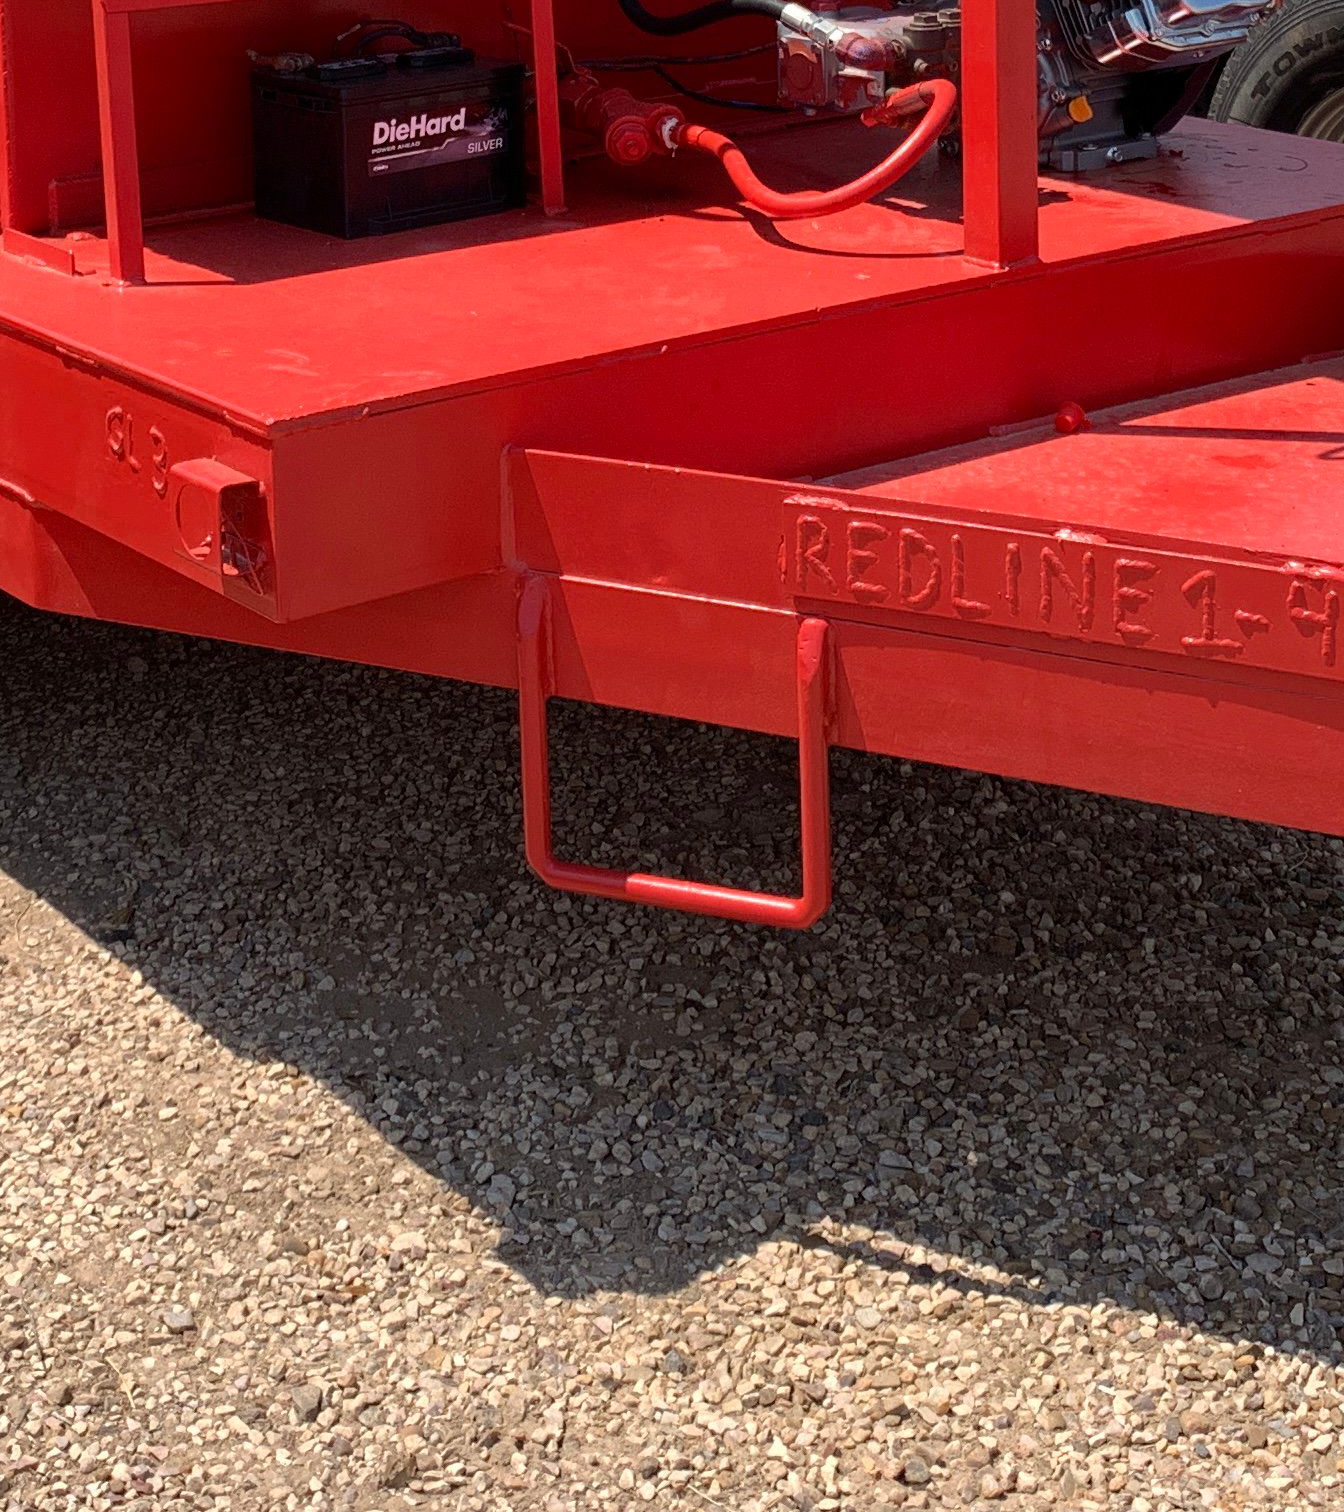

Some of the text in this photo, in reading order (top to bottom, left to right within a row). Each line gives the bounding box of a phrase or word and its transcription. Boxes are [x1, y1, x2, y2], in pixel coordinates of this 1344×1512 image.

[372, 106, 466, 146] DieHard
[371, 145, 396, 155] POWER
[467, 137, 504, 154] SILVER
[795, 514, 1159, 643] REDLINE
